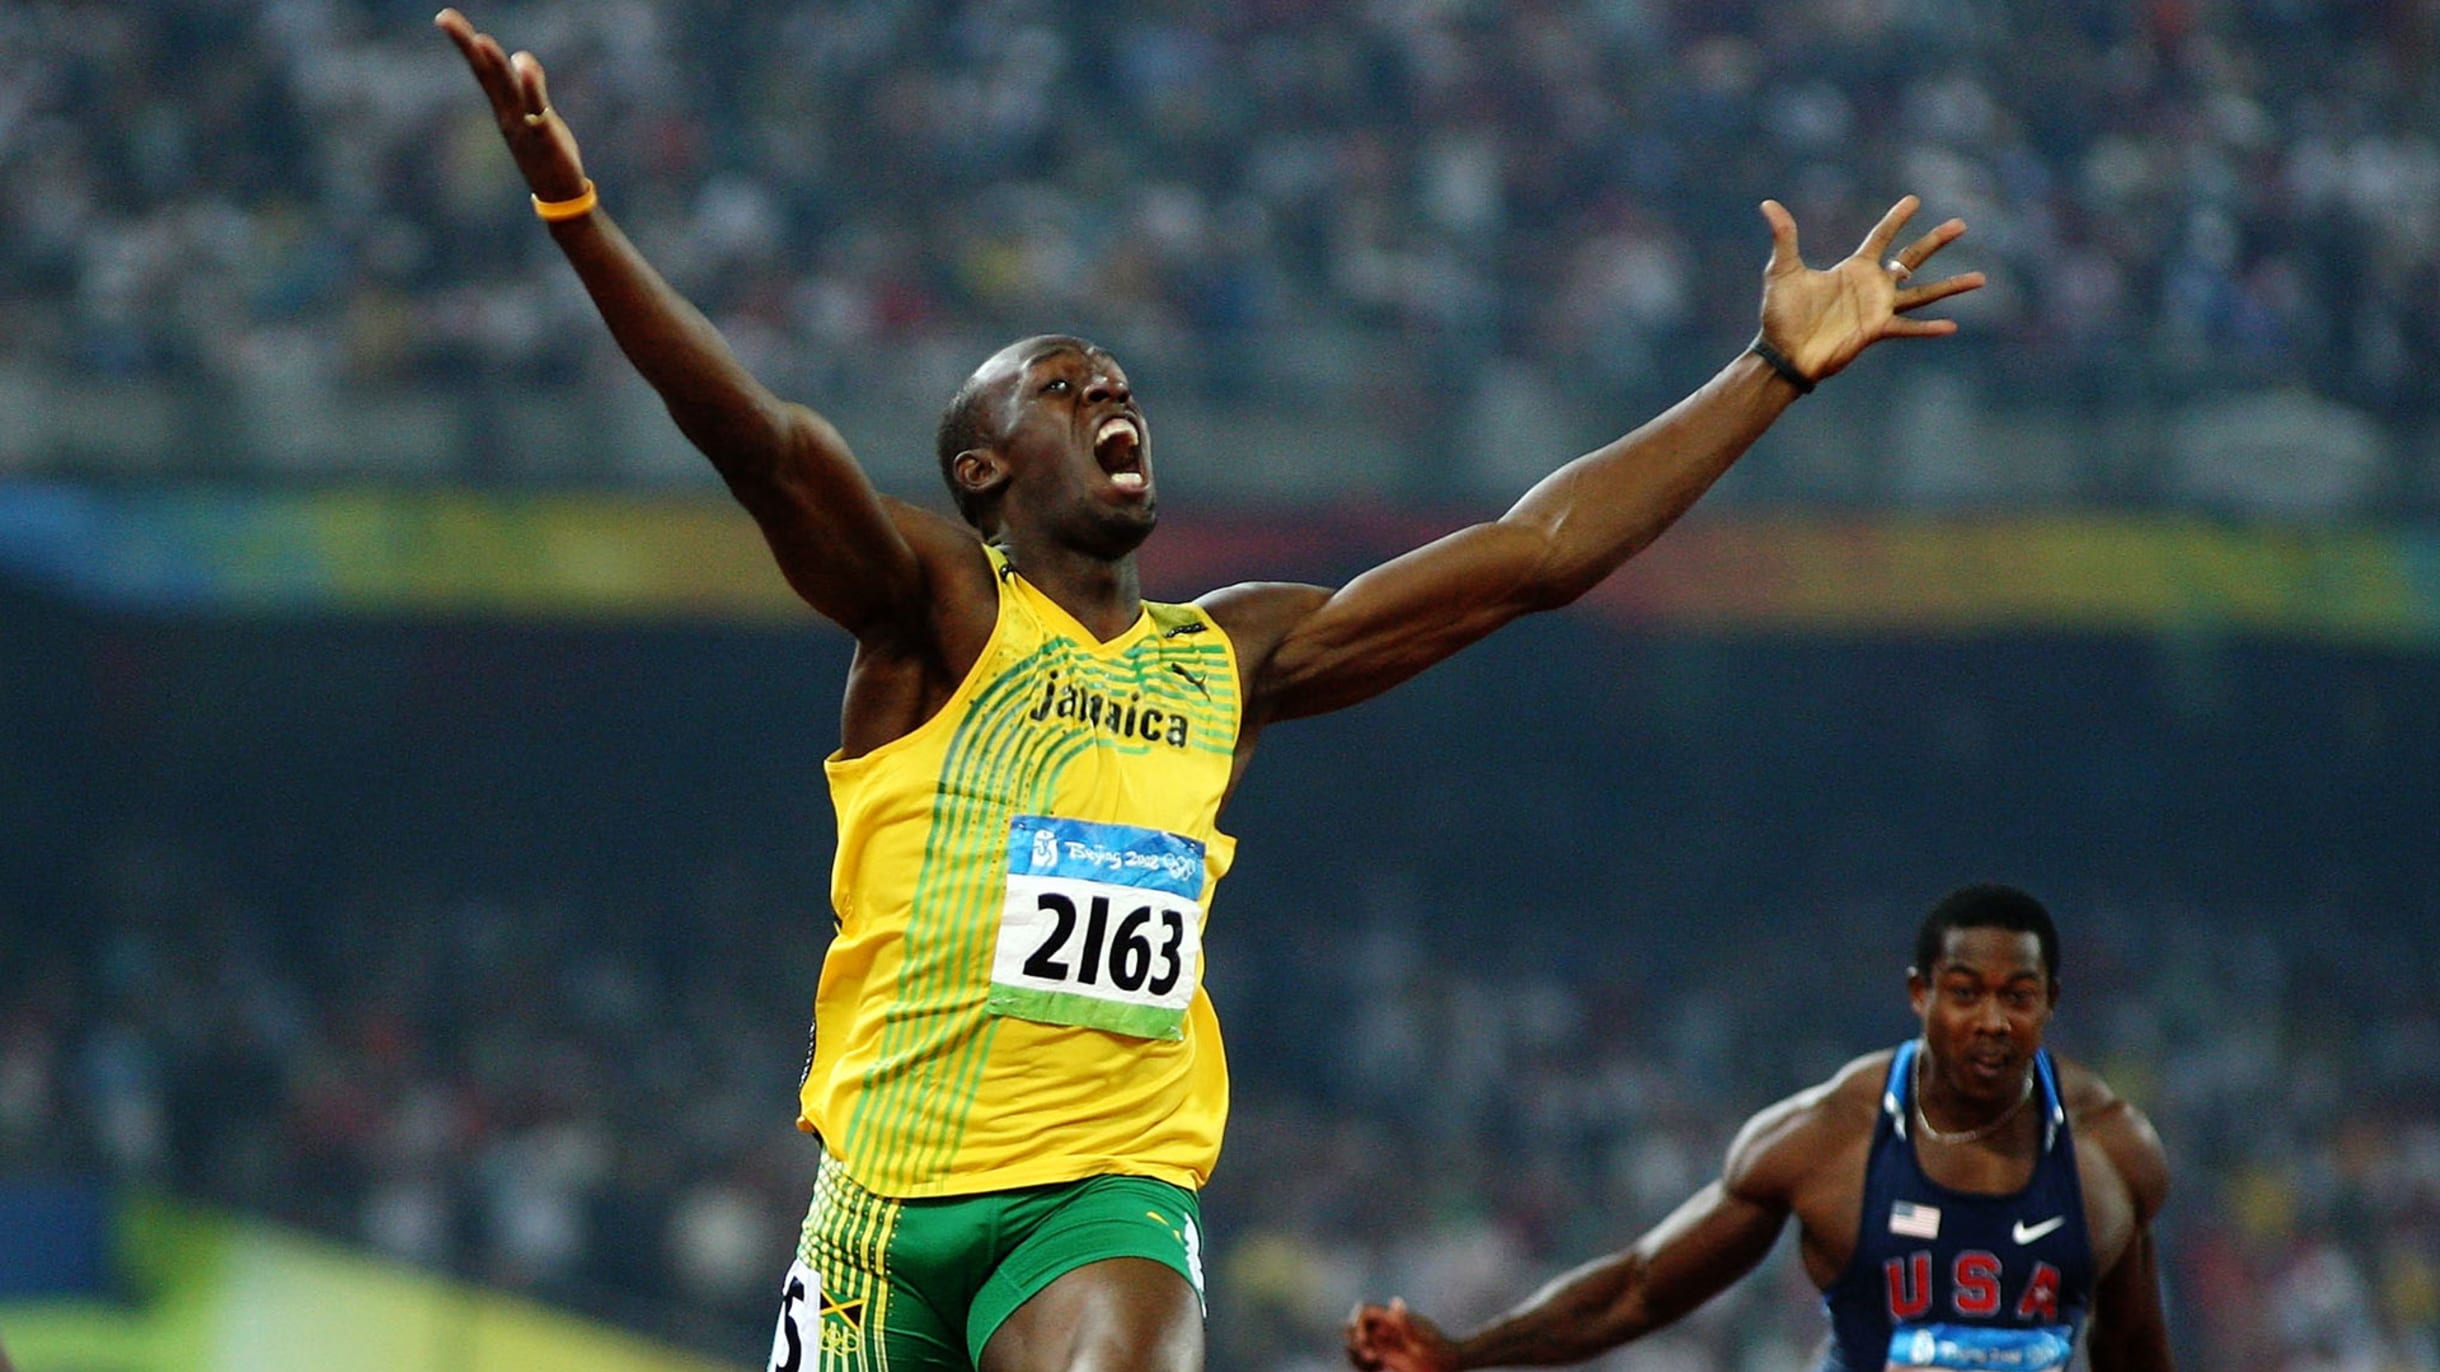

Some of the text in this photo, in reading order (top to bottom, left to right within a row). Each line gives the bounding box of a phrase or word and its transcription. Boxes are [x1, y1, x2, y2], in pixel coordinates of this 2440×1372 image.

[1064, 841, 1160, 870] Beijing 2008
[1022, 892, 1184, 996] 2163
[1885, 1250, 2062, 1320] USA
